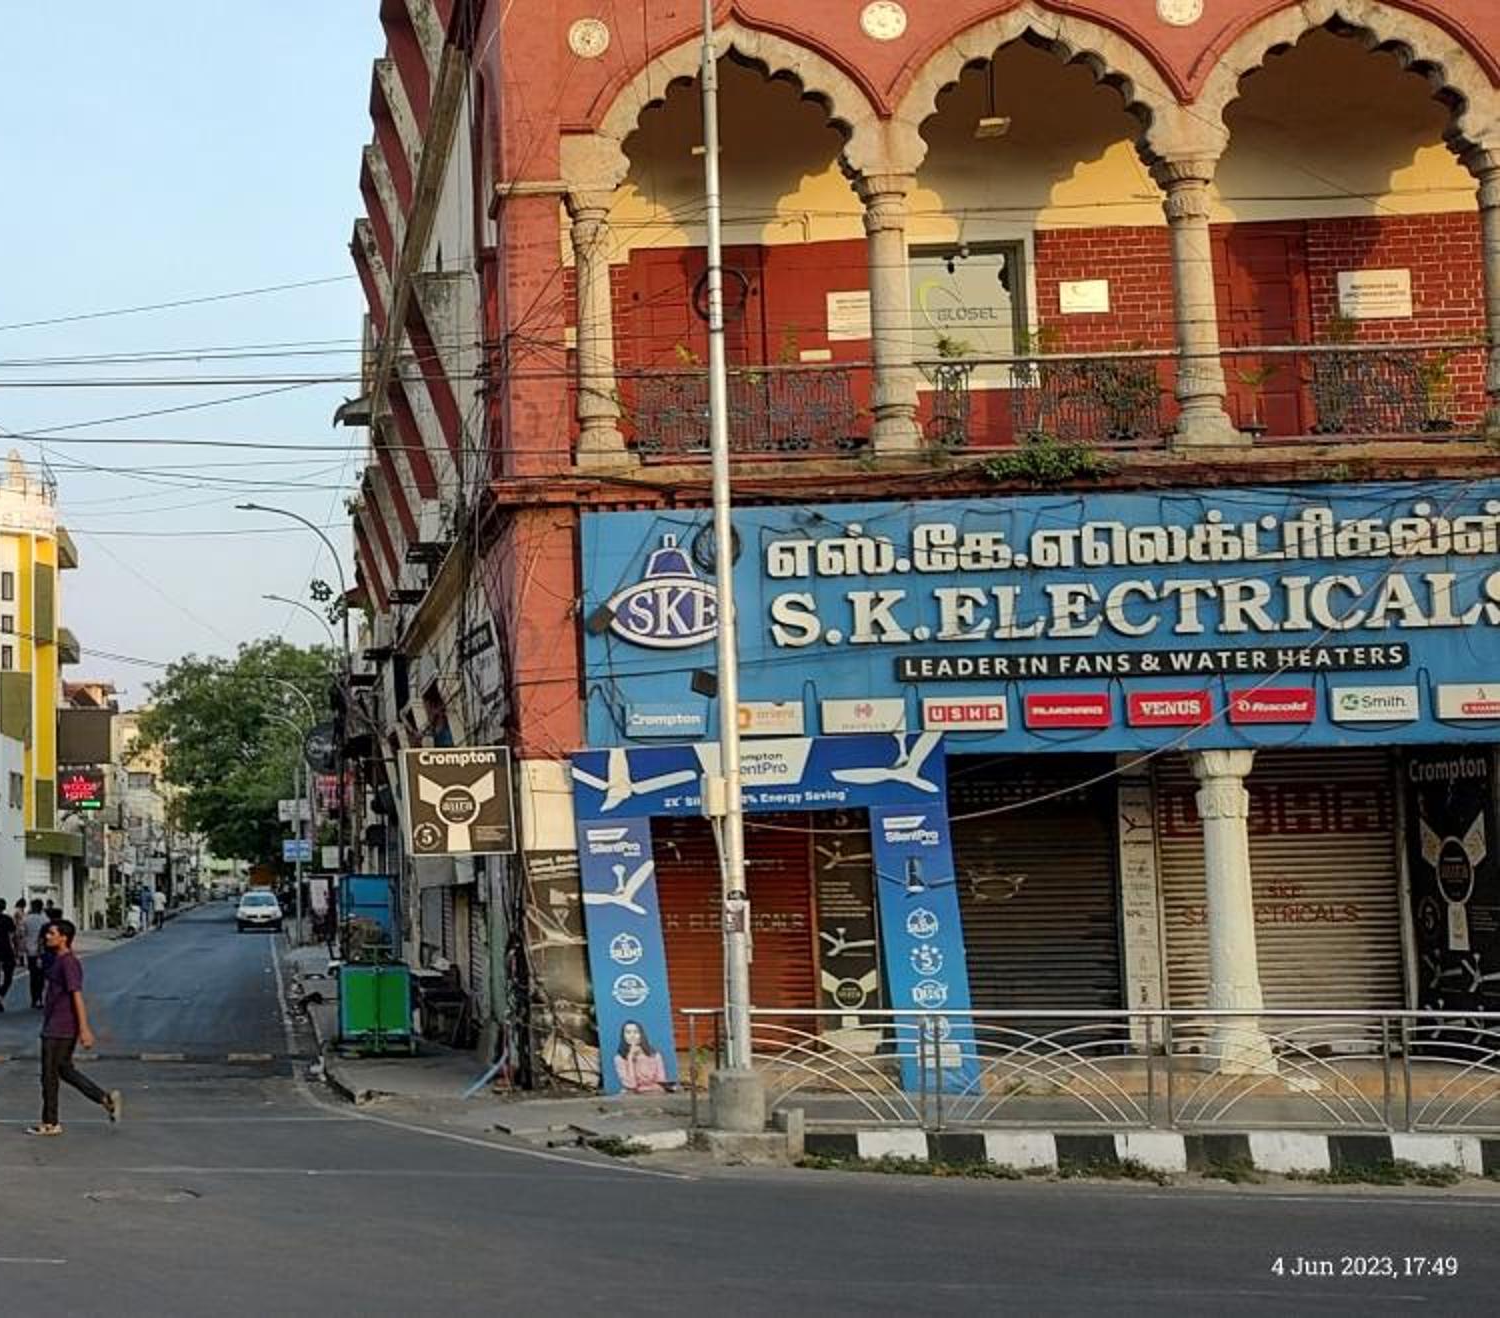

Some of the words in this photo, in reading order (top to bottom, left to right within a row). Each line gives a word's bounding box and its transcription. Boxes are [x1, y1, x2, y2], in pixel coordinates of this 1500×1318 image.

[904, 656, 1012, 678] LEADER
[1018, 656, 1048, 674] IN
[1059, 654, 1131, 674] FANS
[1140, 652, 1161, 671] &
[1170, 648, 1268, 671] WATER
[1277, 643, 1404, 669] HEATERS
[1140, 700, 1201, 715] VENUS
[631, 712, 702, 728] Crompton
[418, 750, 497, 767] Crompton
[1408, 756, 1488, 785] Crompton
